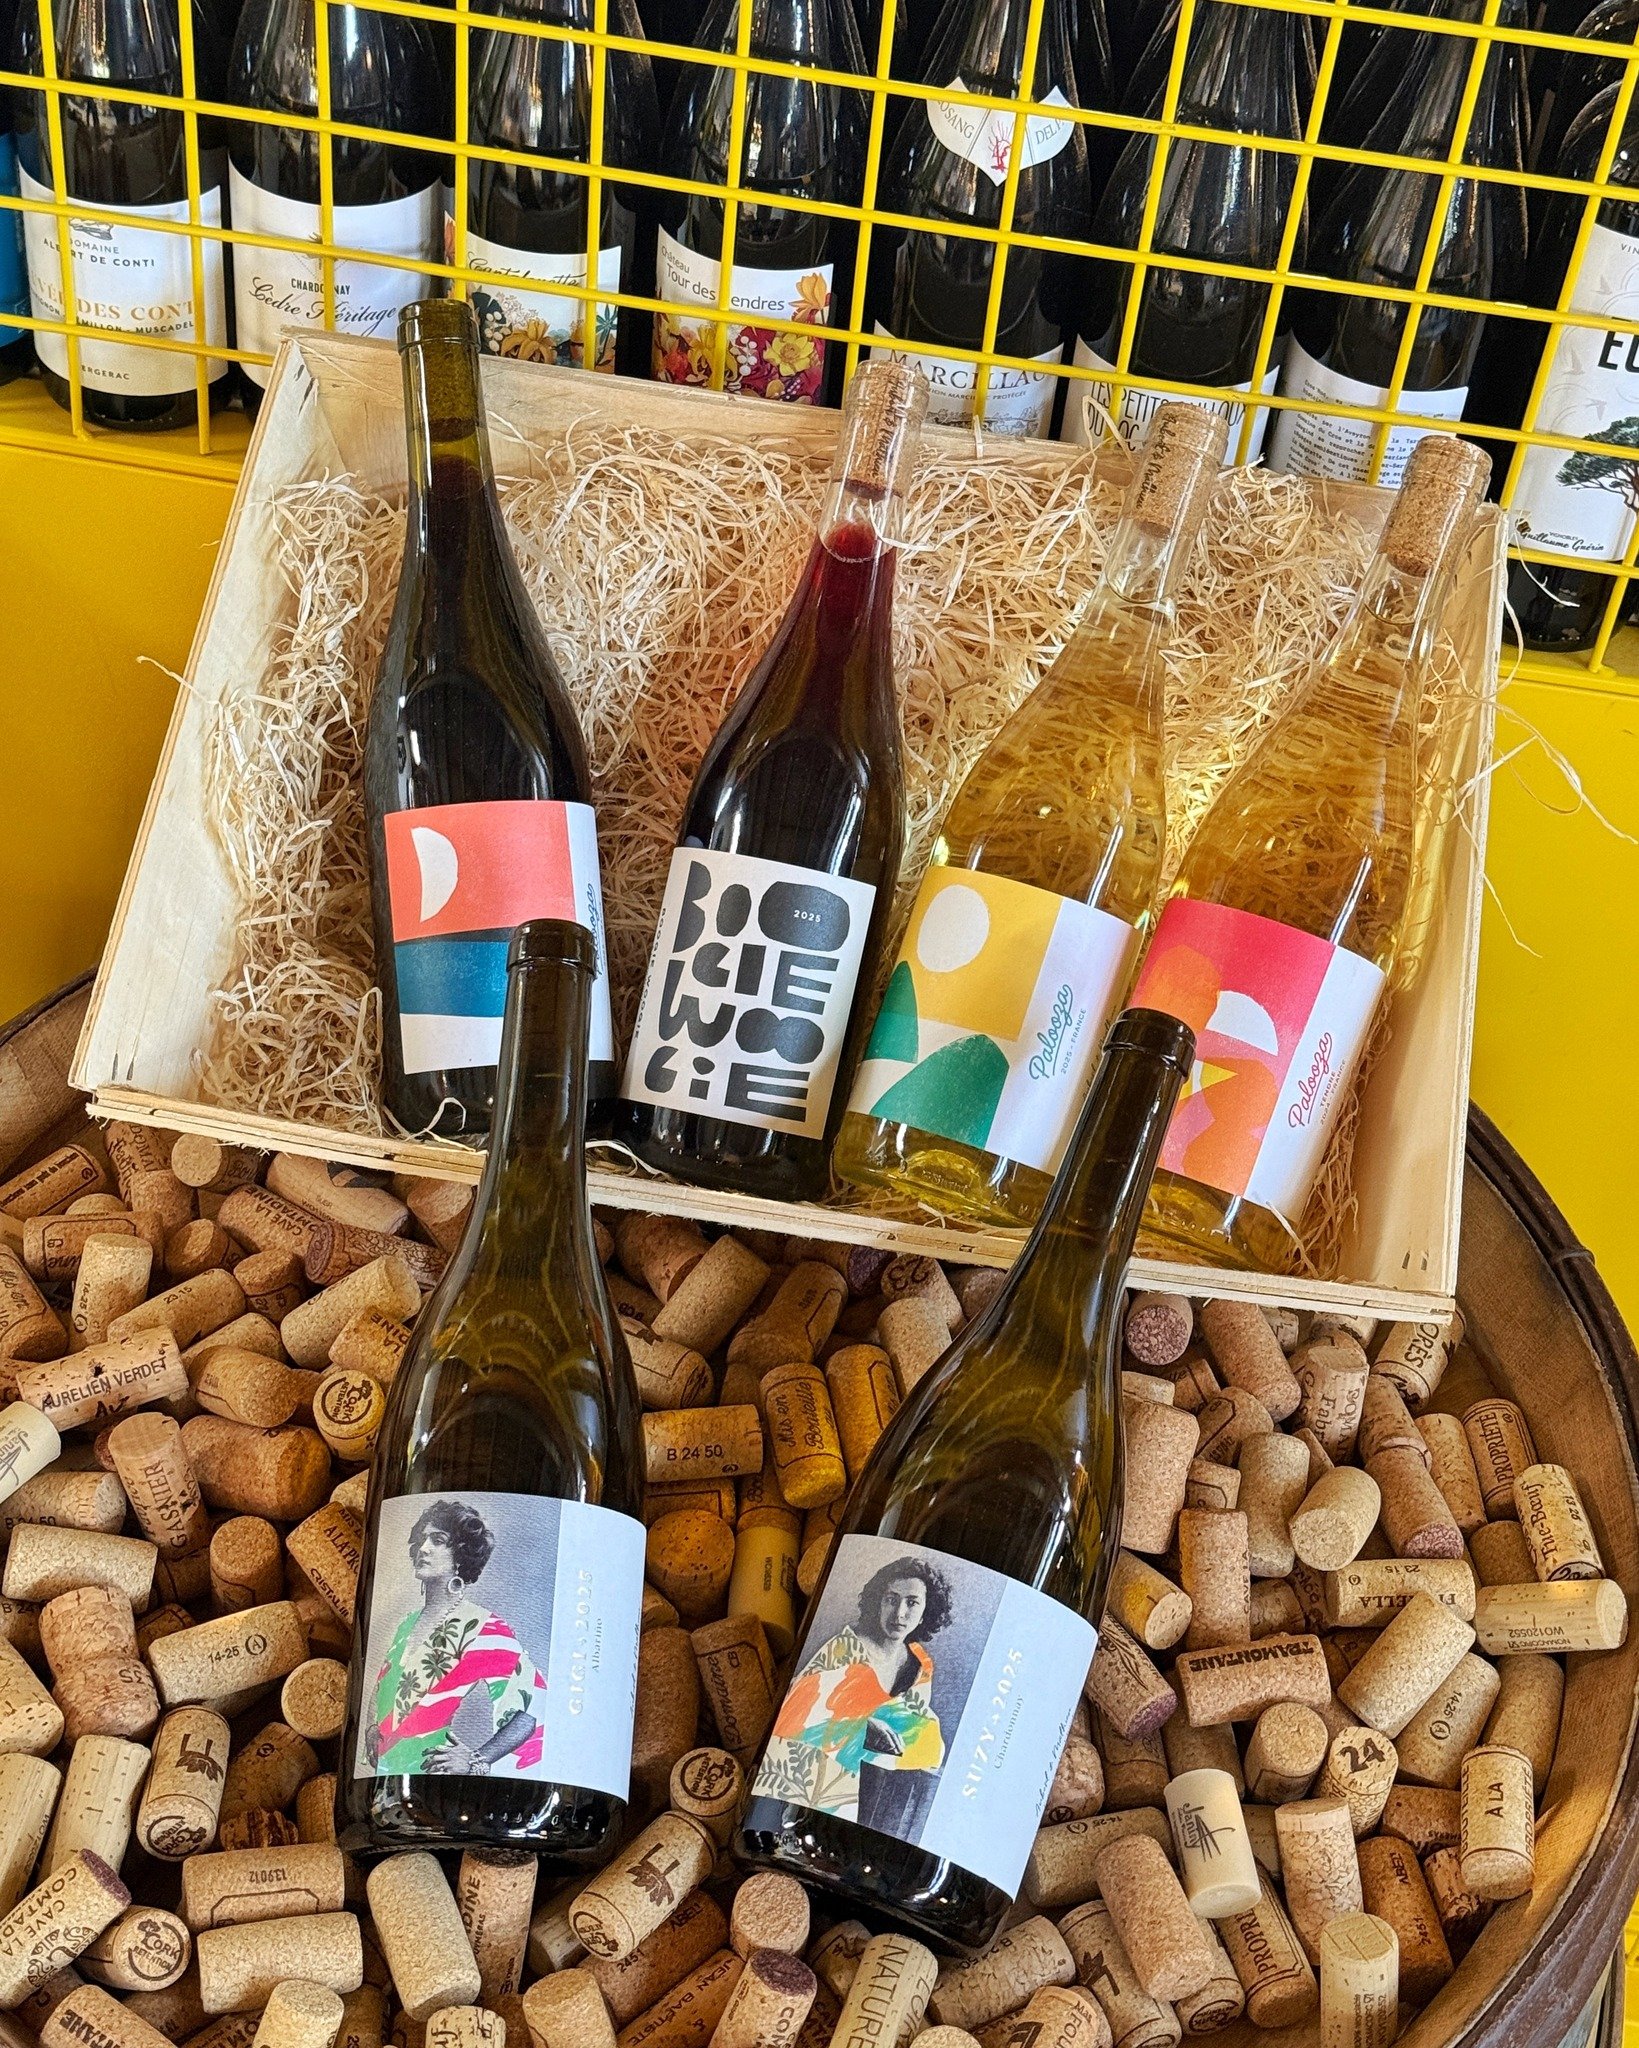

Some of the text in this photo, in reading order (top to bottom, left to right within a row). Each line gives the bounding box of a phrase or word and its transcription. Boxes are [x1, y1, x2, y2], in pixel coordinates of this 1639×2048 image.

[90, 254, 107, 265] DE
[112, 257, 155, 268] CONTI
[666, 262, 785, 311] Tour des endres
[76, 297, 121, 321] DES
[130, 299, 194, 322] CONT
[80, 364, 131, 381] ERGERAC
[1571, 538, 1605, 553] Guérin
[792, 908, 822, 924] 2025
[649, 906, 667, 969] BOOGIE
[1028, 983, 1074, 1083] Palooza
[1059, 1008, 1088, 1076] 2025 FRANCE
[1287, 1031, 1334, 1130] Palooza
[1318, 1069, 1337, 1108] TENDRE
[255, 1203, 303, 1236] CAVE LA
[39, 1357, 169, 1414] AURELIEN VERDET
[774, 1393, 790, 1416] en
[666, 1443, 724, 1462] B 24 50
[1478, 1411, 1516, 1482] PROPRIÉTÉ
[145, 1458, 188, 1549] GASNIER
[569, 1569, 594, 1718] GIGI 2025
[1507, 1626, 1565, 1639] WO120552
[207, 1645, 240, 1664] 14-25
[1189, 1641, 1315, 1674] TRAMONTANE
[1440, 1689, 1463, 1721] 14-25
[961, 1647, 1024, 1800] SUZY 2025
[993, 1693, 1025, 1770] Chardonnay
[1339, 1737, 1388, 1775] 24
[1486, 1781, 1505, 1803] LA
[0, 1866, 78, 1952] COMTAD
[1, 1899, 67, 1958] CAVE LA
[143, 1931, 181, 1958] CORK
[616, 1948, 646, 1974] 2451
[695, 1957, 737, 1992] JEAN
[850, 1943, 909, 2048] NATURE
[1073, 2000, 1094, 2024] Mas
